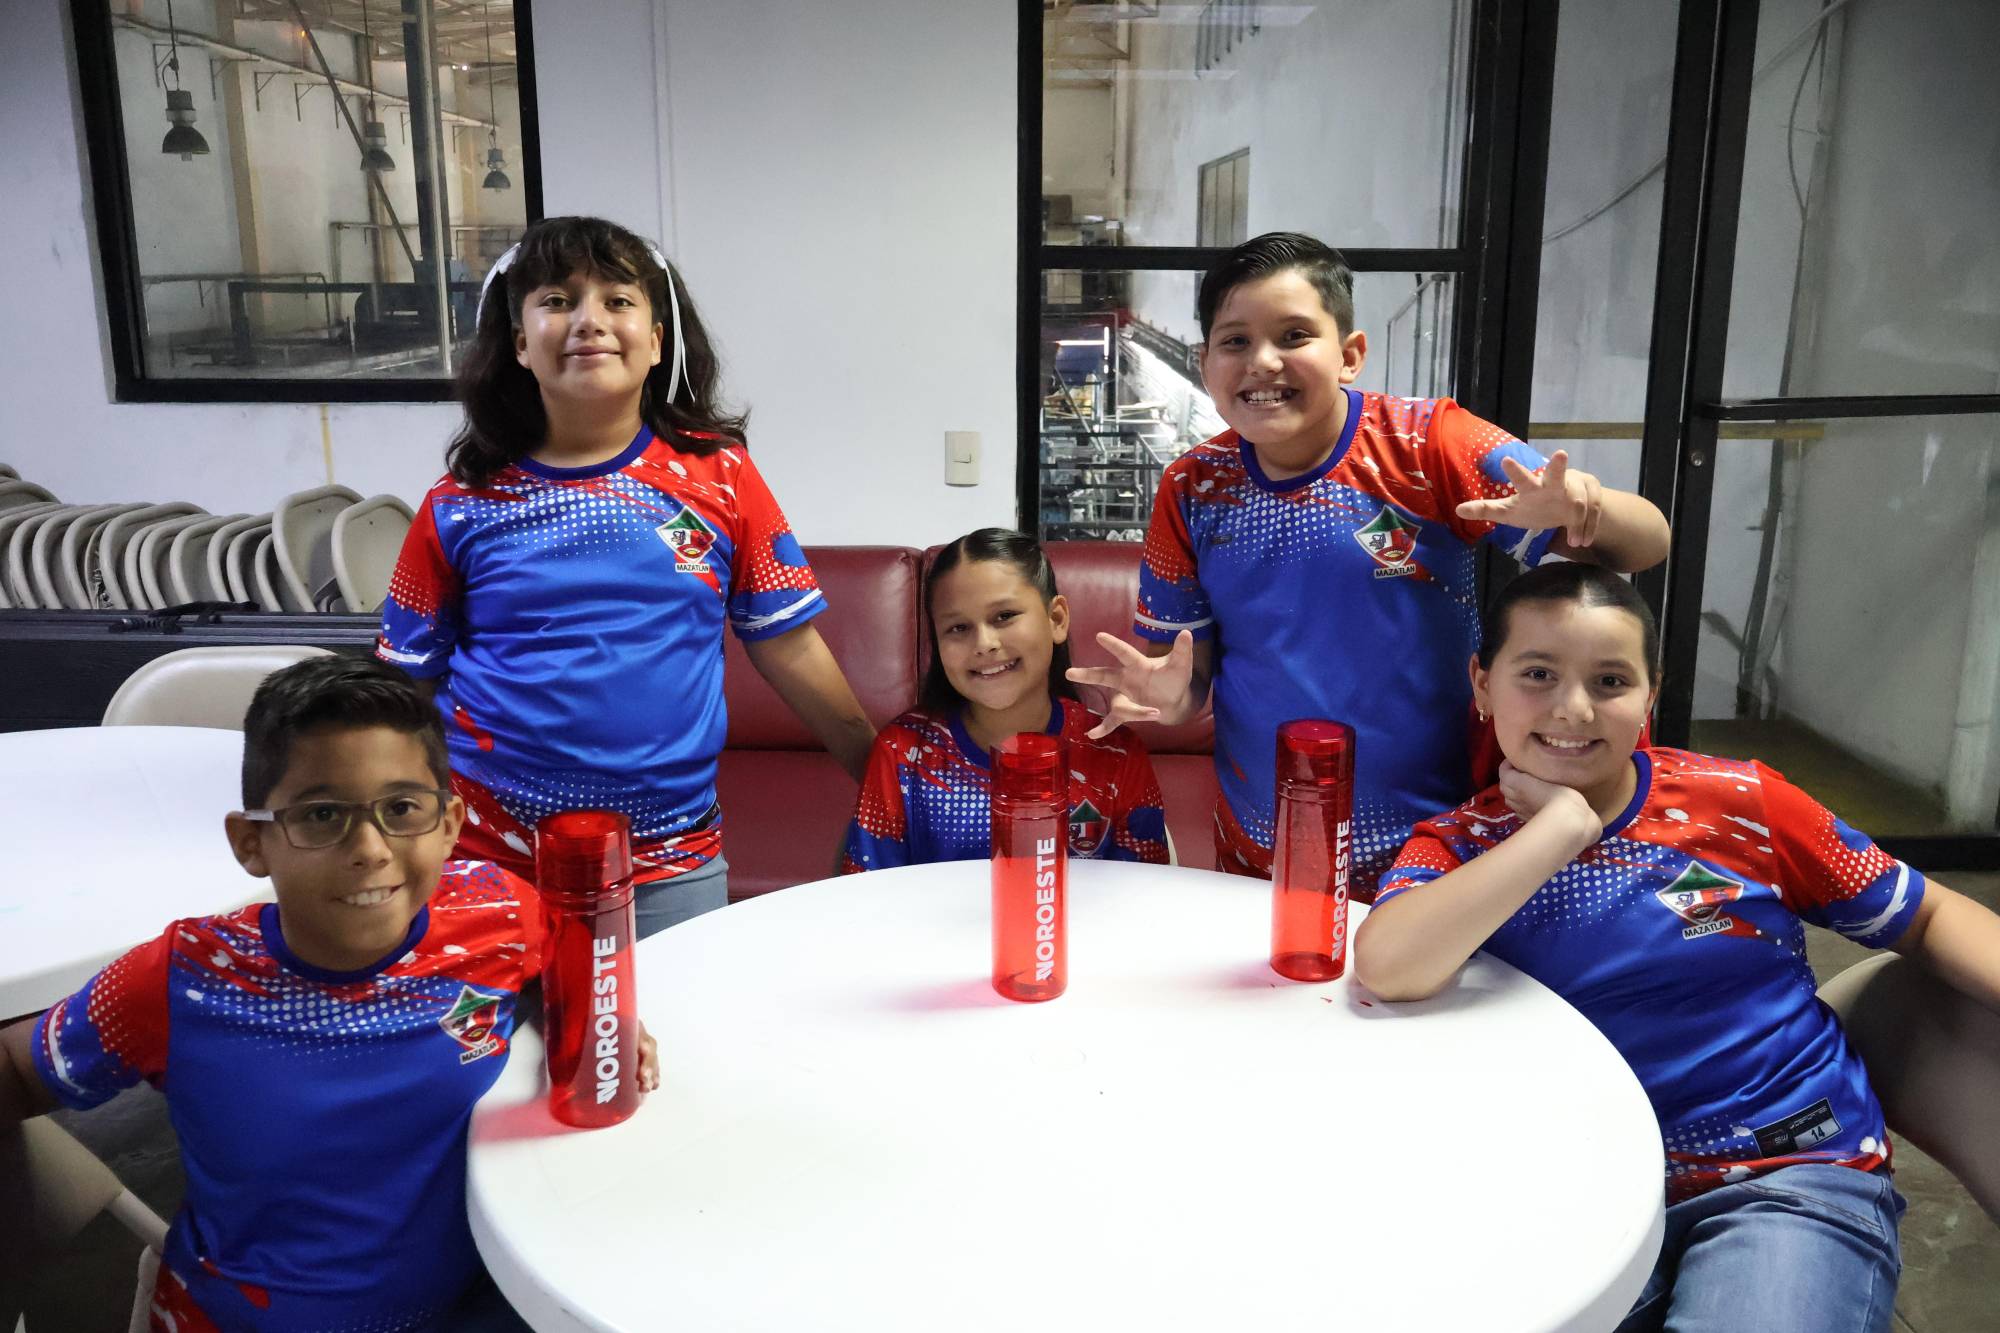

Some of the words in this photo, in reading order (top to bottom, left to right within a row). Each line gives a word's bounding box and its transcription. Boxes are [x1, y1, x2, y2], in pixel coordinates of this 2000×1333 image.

[676, 564, 709, 572] MAZATLAN
[1375, 565, 1415, 577] MAZATLAN
[1331, 819, 1350, 962] NOROESTE
[1036, 837, 1056, 981] NOROESTE
[1684, 919, 1732, 938] MAZATLAN
[593, 935, 620, 1105] NOROESTE
[461, 1040, 497, 1062] MAZATLAN
[1811, 1125, 1825, 1141] 14
